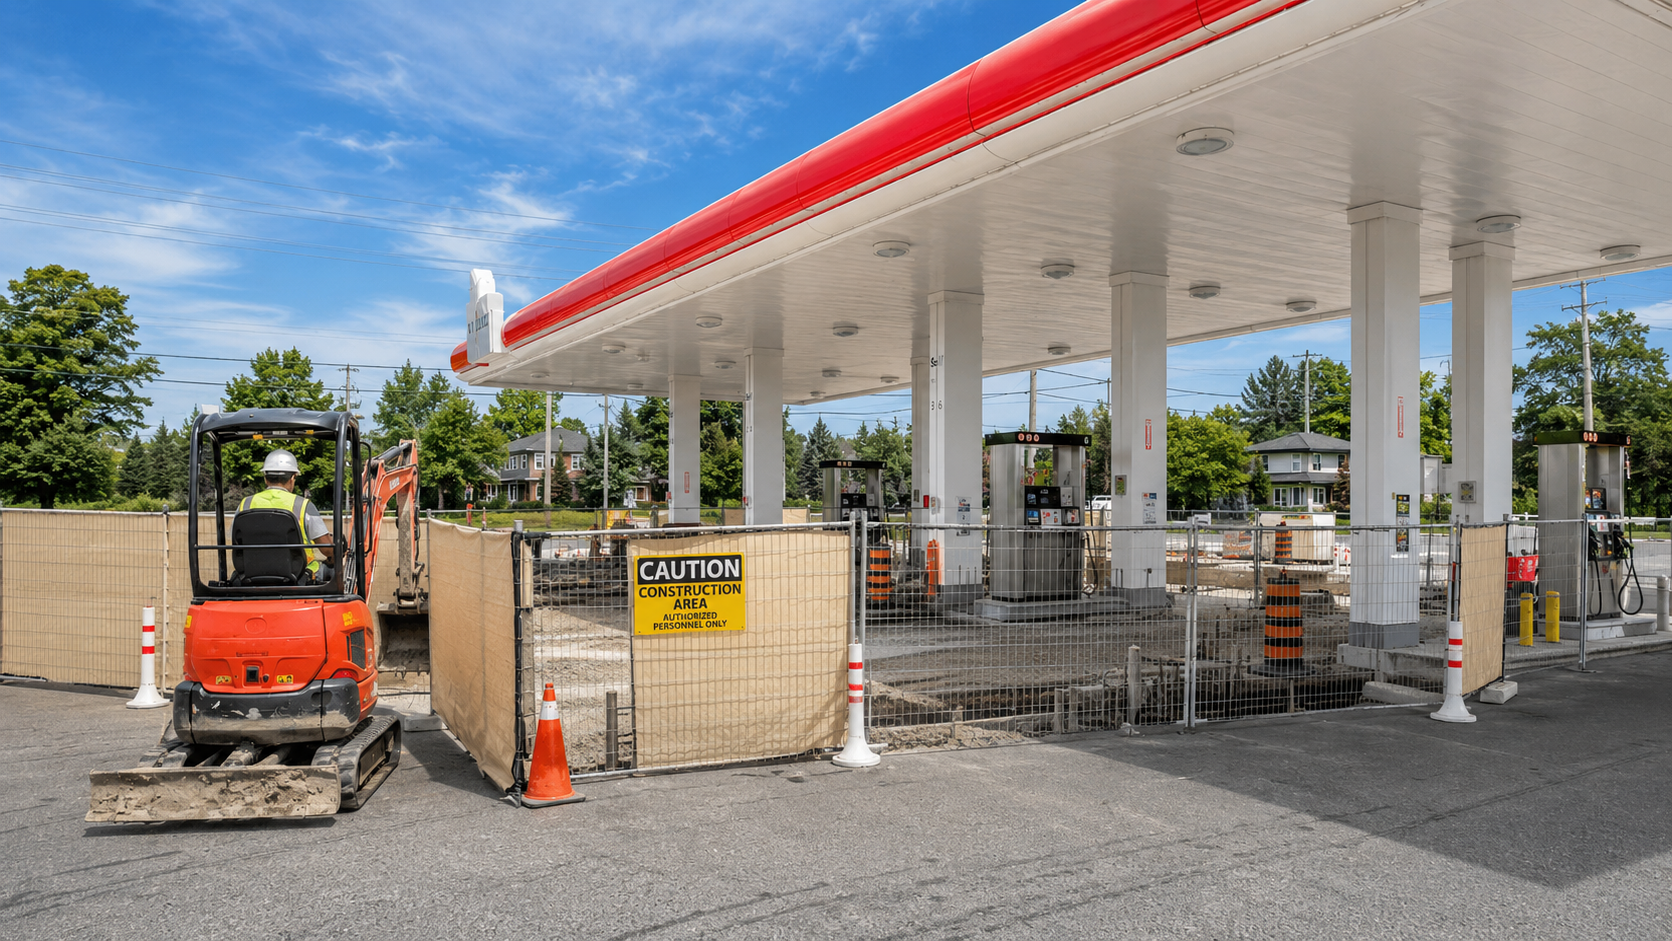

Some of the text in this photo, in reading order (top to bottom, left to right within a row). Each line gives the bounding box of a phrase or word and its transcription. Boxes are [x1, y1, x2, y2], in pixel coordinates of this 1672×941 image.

[639, 559, 740, 580] CAUTION
[639, 584, 741, 598] CONSTRUCTION
[673, 598, 708, 610] AREA
[663, 612, 718, 621] AUTHORIZED
[653, 619, 728, 630] PERSONNEL ONLY
